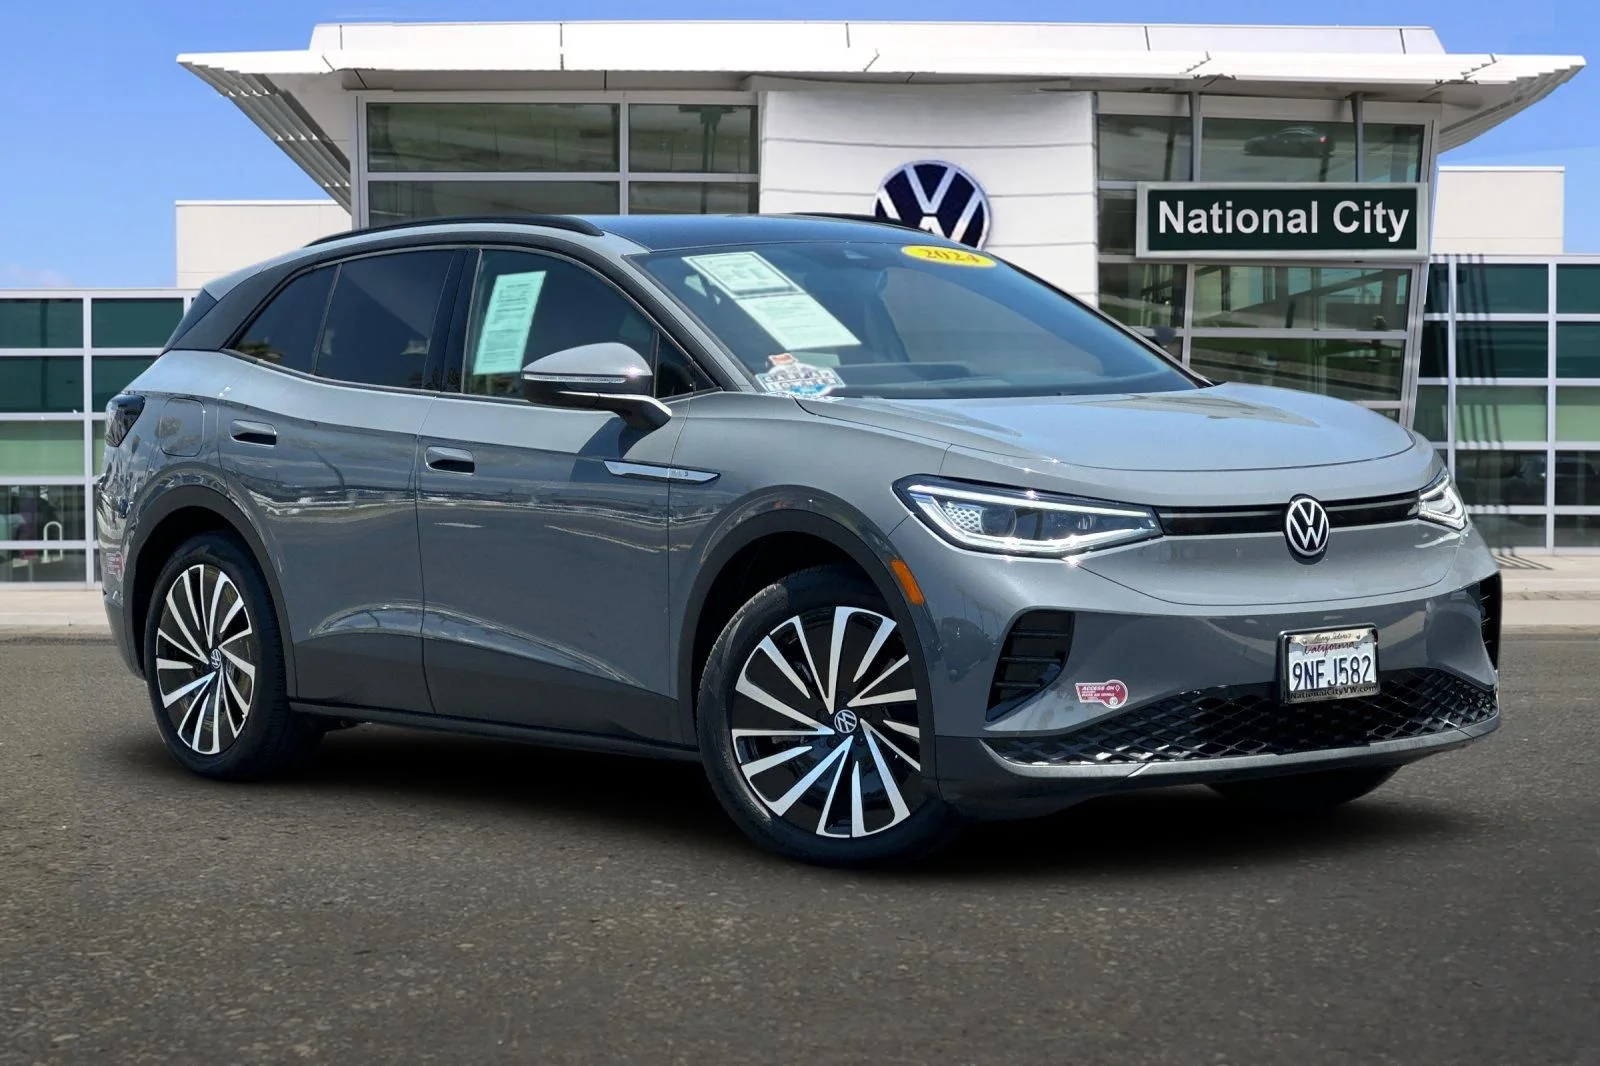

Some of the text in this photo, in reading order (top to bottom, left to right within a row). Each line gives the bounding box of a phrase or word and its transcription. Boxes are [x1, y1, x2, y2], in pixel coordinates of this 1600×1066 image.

[1158, 200, 1410, 243] National City
[1287, 498, 1329, 554] VW
[1292, 655, 1373, 691] 9NFJ582
